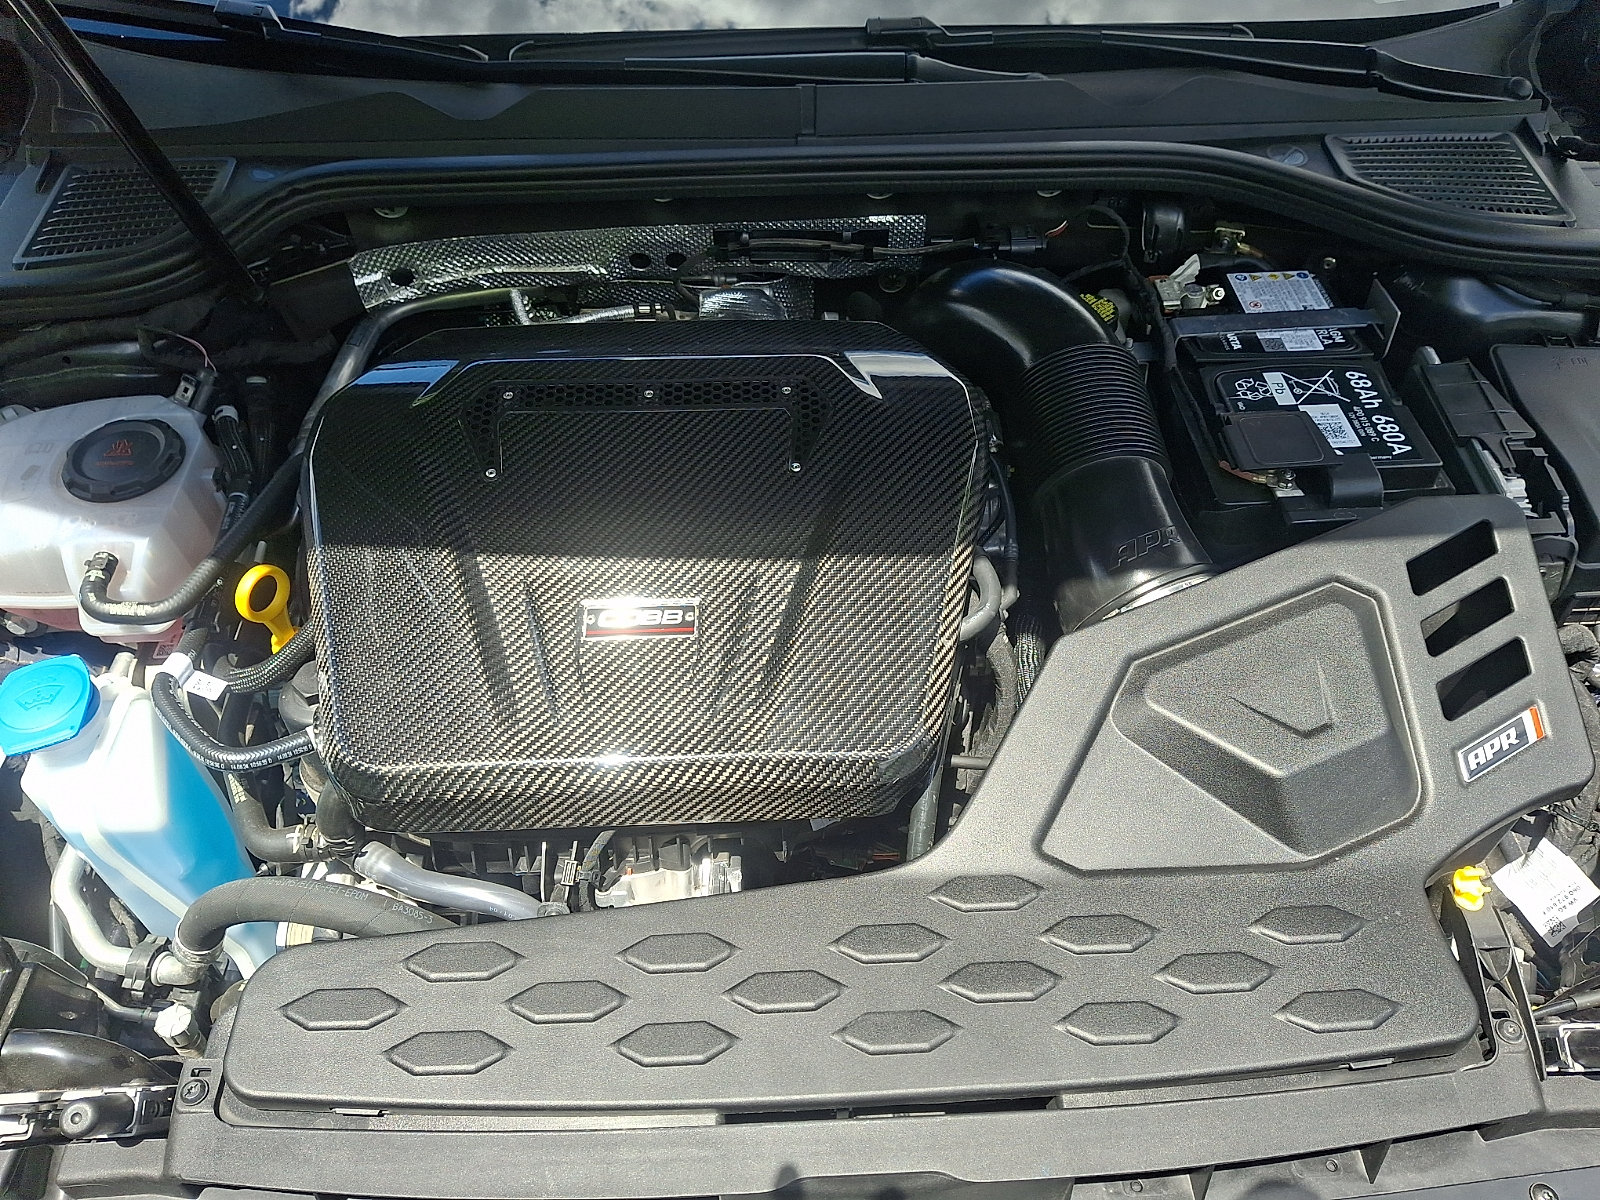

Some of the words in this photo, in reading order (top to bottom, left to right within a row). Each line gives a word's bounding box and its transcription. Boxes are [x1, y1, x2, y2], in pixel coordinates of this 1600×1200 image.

[1227, 333, 1242, 350] ARTA
[1316, 329, 1333, 345] RLA
[1272, 382, 1286, 394] Pb
[1345, 371, 1383, 409] 68Ah
[1371, 414, 1412, 456] 680A
[1108, 525, 1182, 573] APR
[1467, 727, 1520, 771] APR
